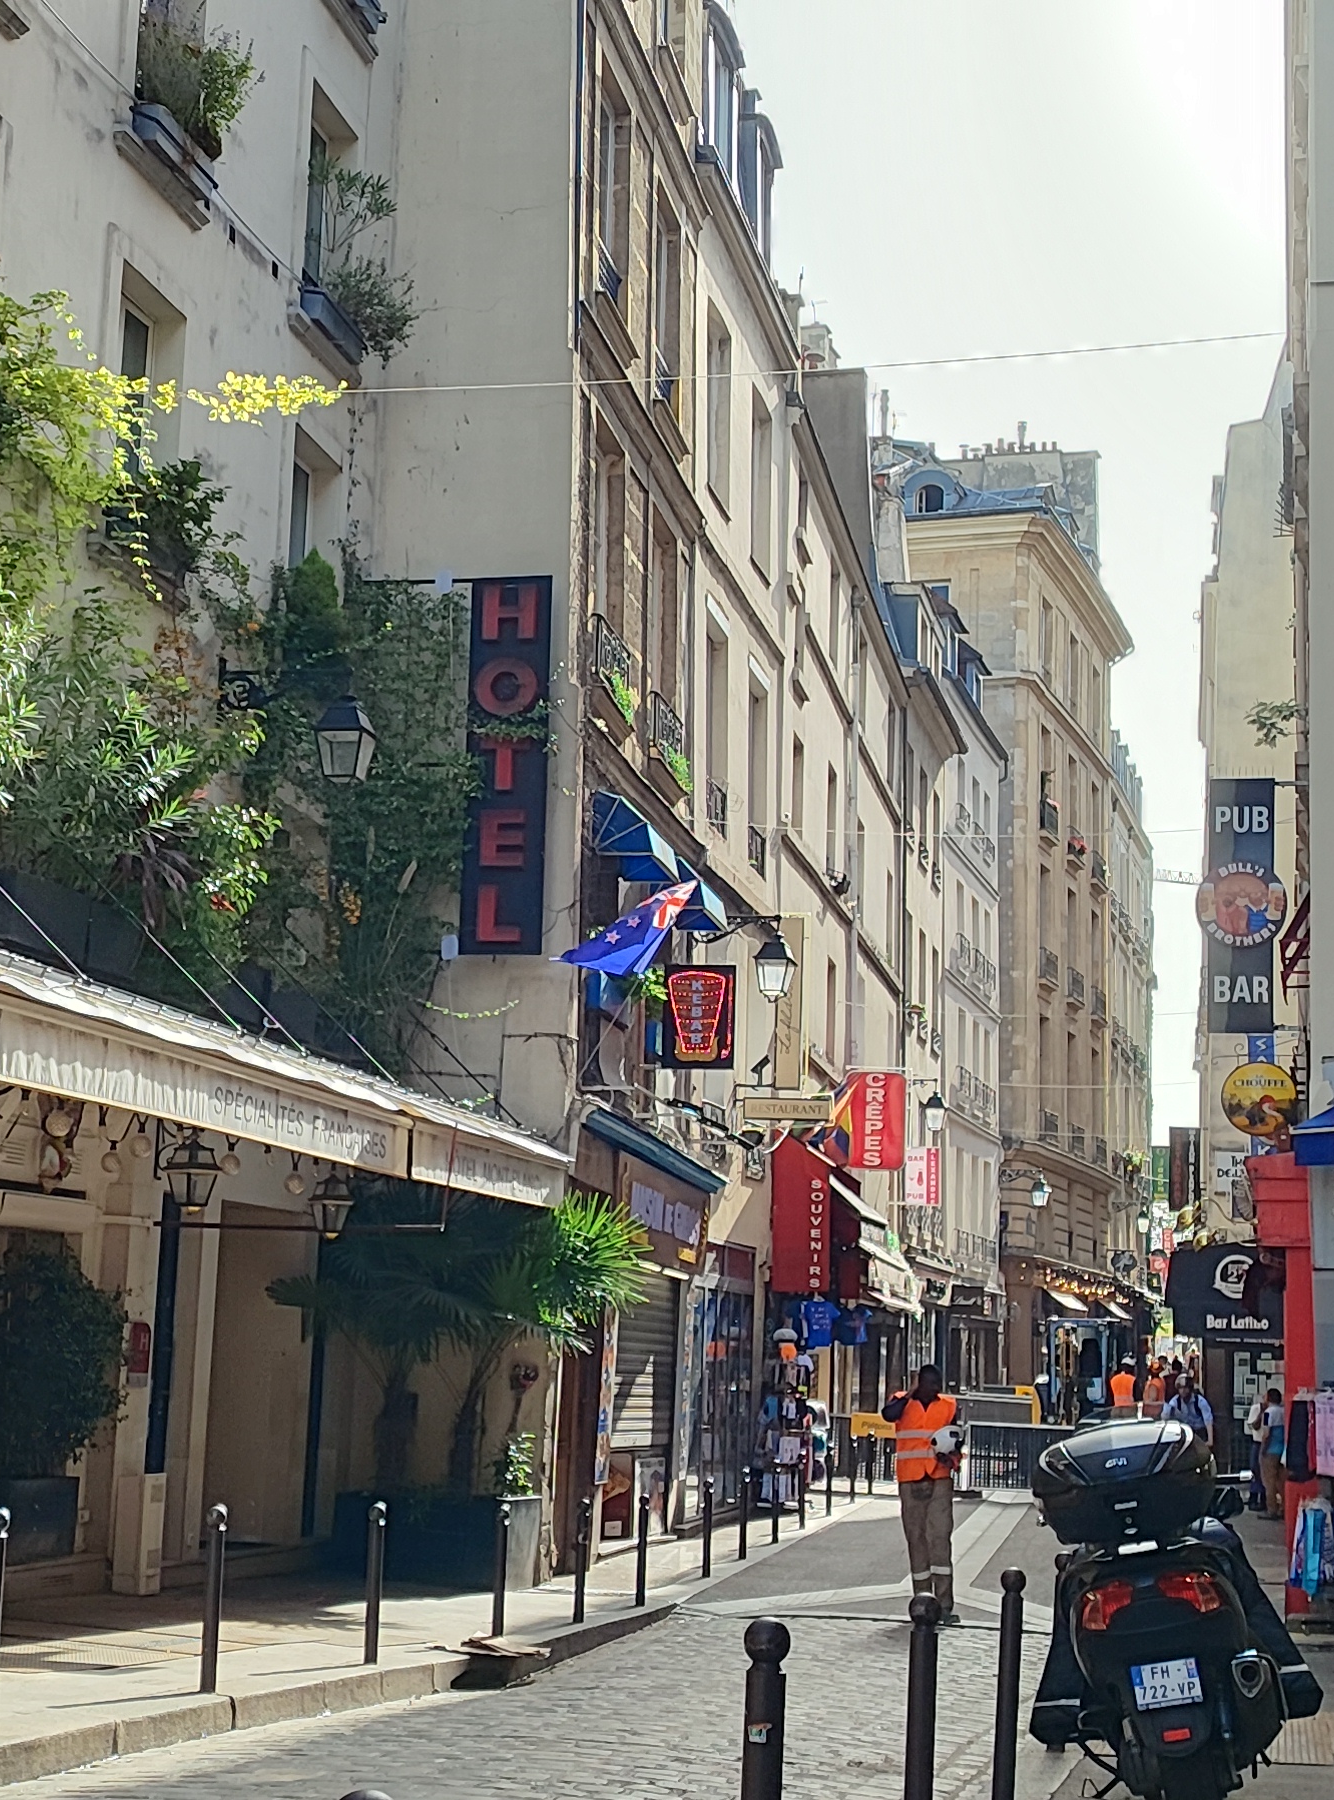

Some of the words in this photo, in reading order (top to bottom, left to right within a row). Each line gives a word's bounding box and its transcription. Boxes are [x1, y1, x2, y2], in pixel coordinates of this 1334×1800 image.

[473, 583, 539, 944] HOTEL
[1214, 806, 1269, 834] PUB
[1213, 975, 1269, 1004] BAR
[691, 980, 704, 1045] KEBAB
[1233, 1078, 1288, 1088] CHOUFFE
[213, 1086, 305, 1137] SPÉCIALITÉS
[750, 1103, 824, 1116] RESTAURANT
[862, 1073, 886, 1166] CRÊPES
[809, 1179, 824, 1288] SOUVENIRS
[1206, 1314, 1228, 1330] Bar
